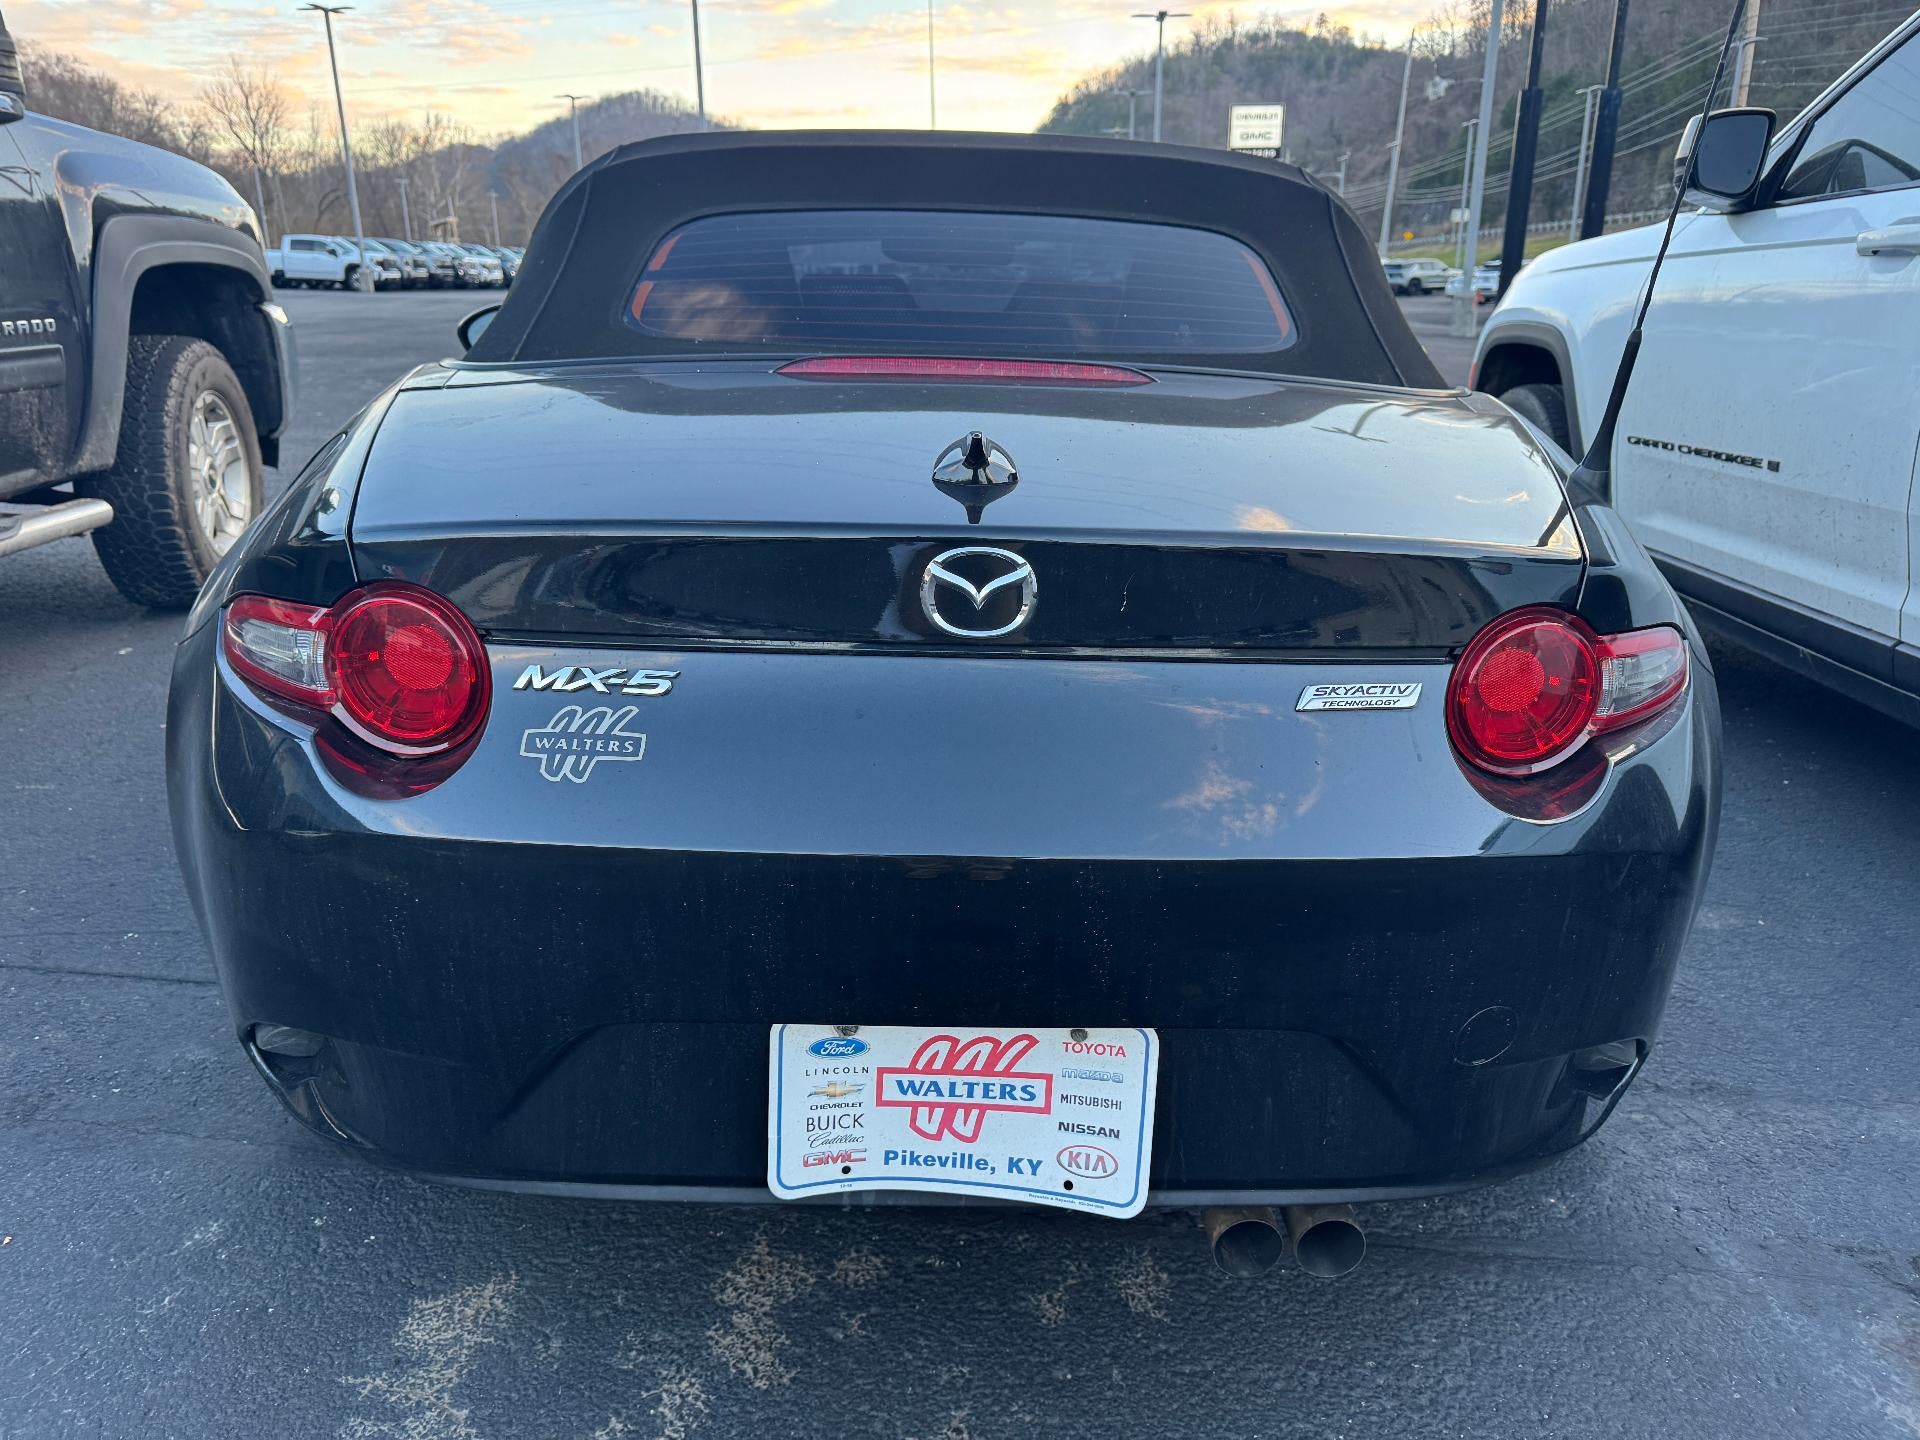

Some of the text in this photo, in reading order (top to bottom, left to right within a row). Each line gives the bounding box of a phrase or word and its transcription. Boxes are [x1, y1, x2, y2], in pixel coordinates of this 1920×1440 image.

[0, 317, 57, 336] RADO
[1627, 435, 1675, 451] GRAND
[1677, 444, 1763, 469] CHEROKEE
[512, 664, 682, 697] MX-5
[1312, 685, 1412, 697] SKYACTIV
[1321, 699, 1401, 708] TECHNOLOGY
[535, 737, 634, 753] WALTERS
[820, 1040, 856, 1056] Ford
[1062, 1041, 1127, 1058] TOYOTA
[805, 1066, 870, 1077] LINCOLN
[895, 1079, 1038, 1102] WALTERS
[810, 1101, 864, 1111] CHEVROLET
[1060, 1093, 1122, 1111] MITSUBISHI
[806, 1113, 865, 1133] BUICK
[1058, 1121, 1121, 1139] NISSAN
[807, 1131, 865, 1148] Cadillac
[802, 1148, 868, 1168] GMC
[883, 1149, 1044, 1177] Pikeville, KY
[1067, 1150, 1108, 1174] KIA
